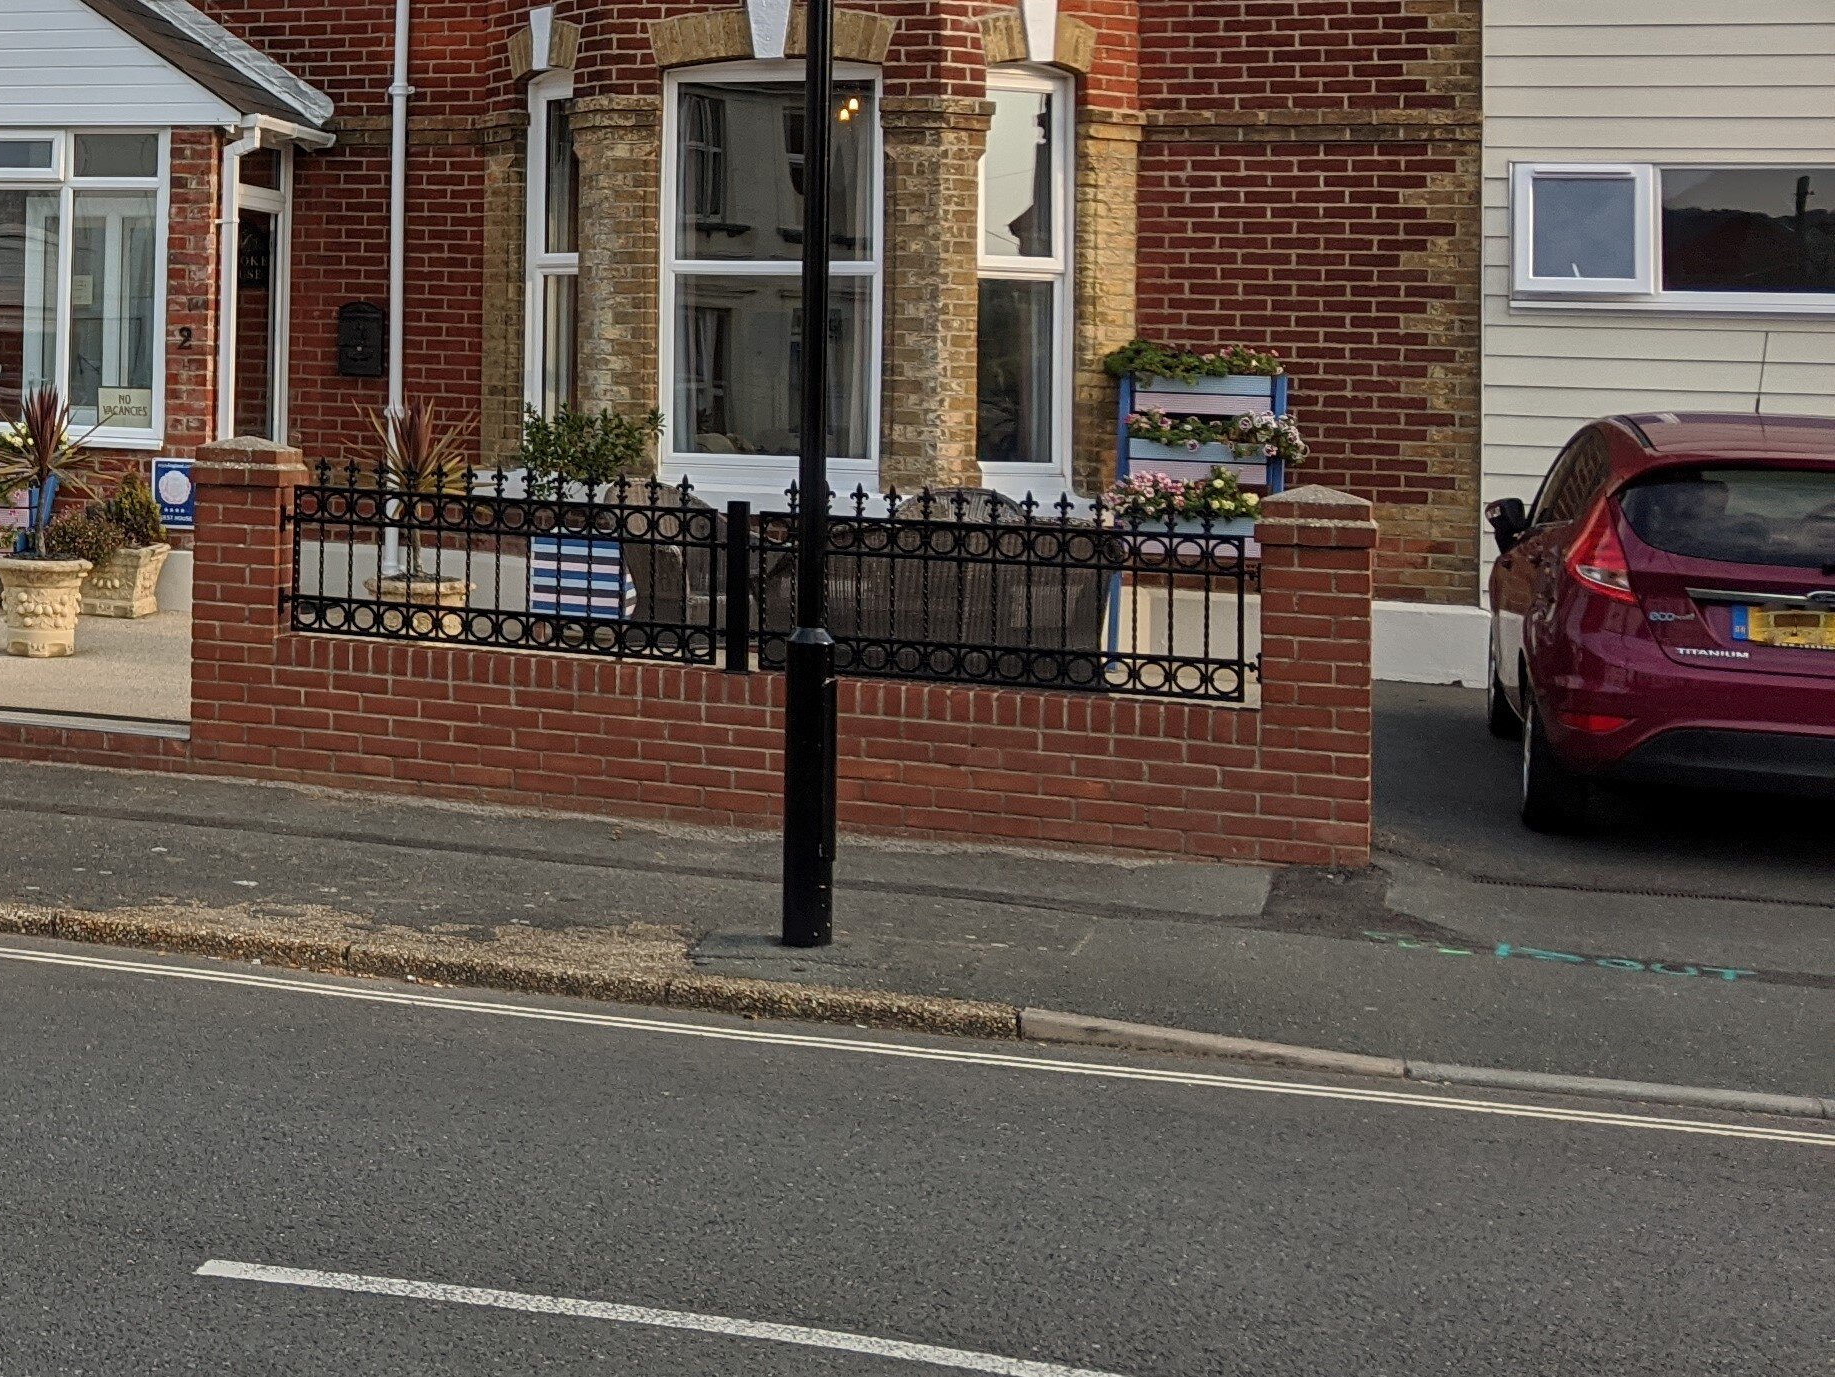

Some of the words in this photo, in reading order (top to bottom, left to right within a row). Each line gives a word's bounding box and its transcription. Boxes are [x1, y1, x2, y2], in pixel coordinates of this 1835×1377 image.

[177, 326, 192, 349] 2
[118, 394, 131, 404] NO
[103, 406, 147, 416] VACANCIES
[1675, 647, 1749, 659] TITANIUM
